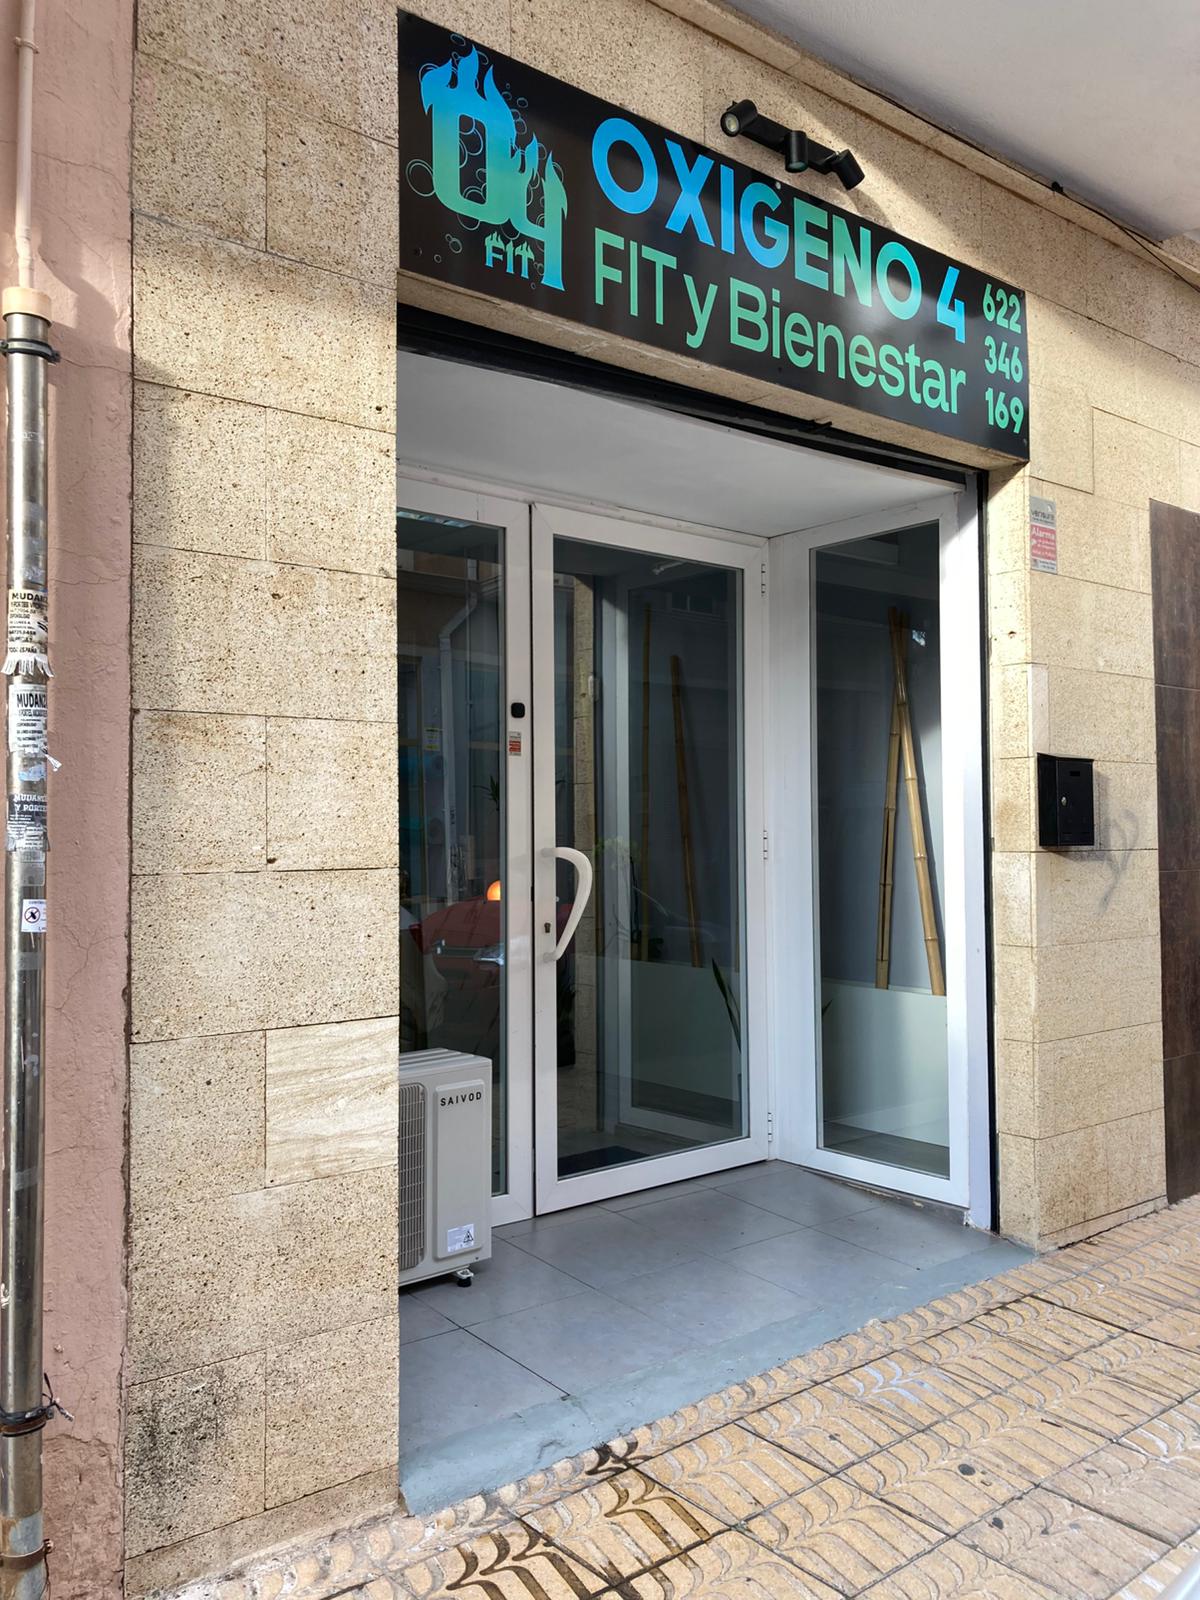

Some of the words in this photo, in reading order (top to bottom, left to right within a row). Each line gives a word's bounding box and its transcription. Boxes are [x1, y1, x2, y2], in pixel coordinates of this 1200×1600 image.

[591, 117, 922, 320] OXIGENO
[936, 265, 966, 344] 4
[485, 231, 535, 280] FIT
[594, 227, 678, 326] FIT
[683, 273, 719, 349] y
[729, 277, 967, 414] Bienestar
[982, 283, 1022, 334] 622
[984, 335, 1024, 384] 346
[985, 387, 1024, 434] 169
[440, 1091, 482, 1107] SAIVOD
